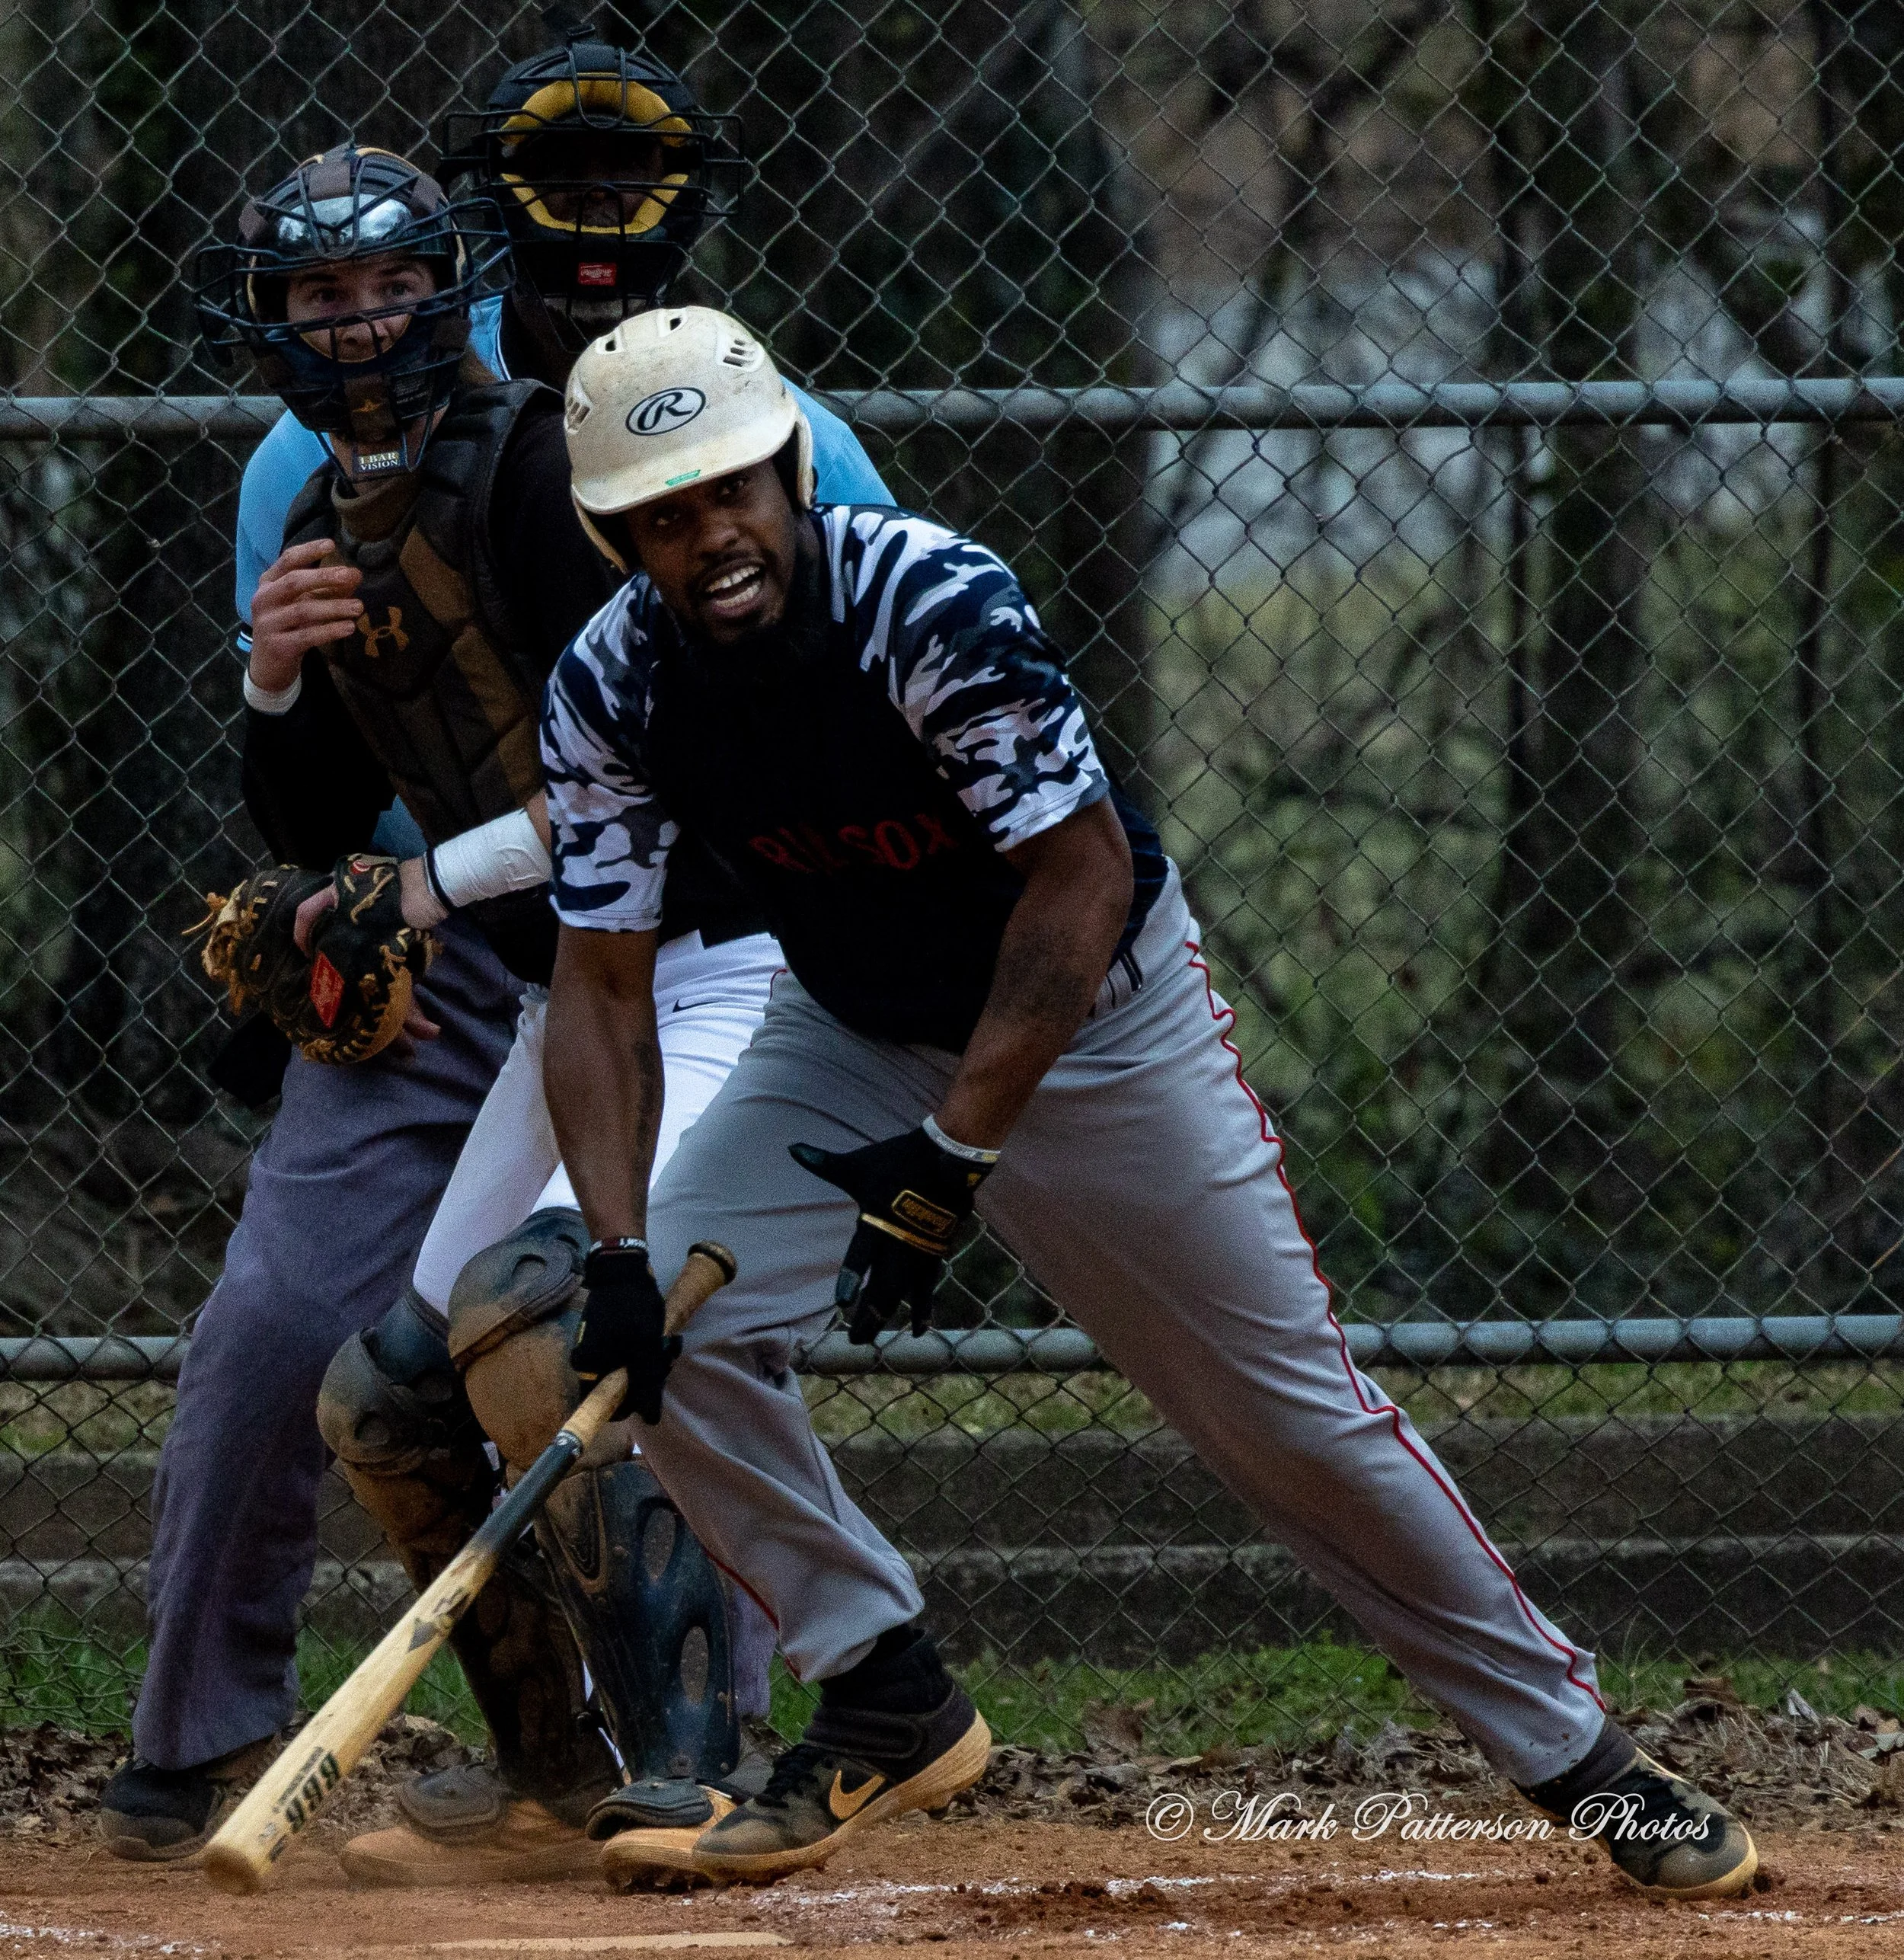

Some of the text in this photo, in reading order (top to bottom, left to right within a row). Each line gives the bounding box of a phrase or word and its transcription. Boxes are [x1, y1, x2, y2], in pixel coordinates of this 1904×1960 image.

[637, 391, 694, 432] R
[369, 452, 398, 463] BAR
[359, 459, 398, 471] VISION
